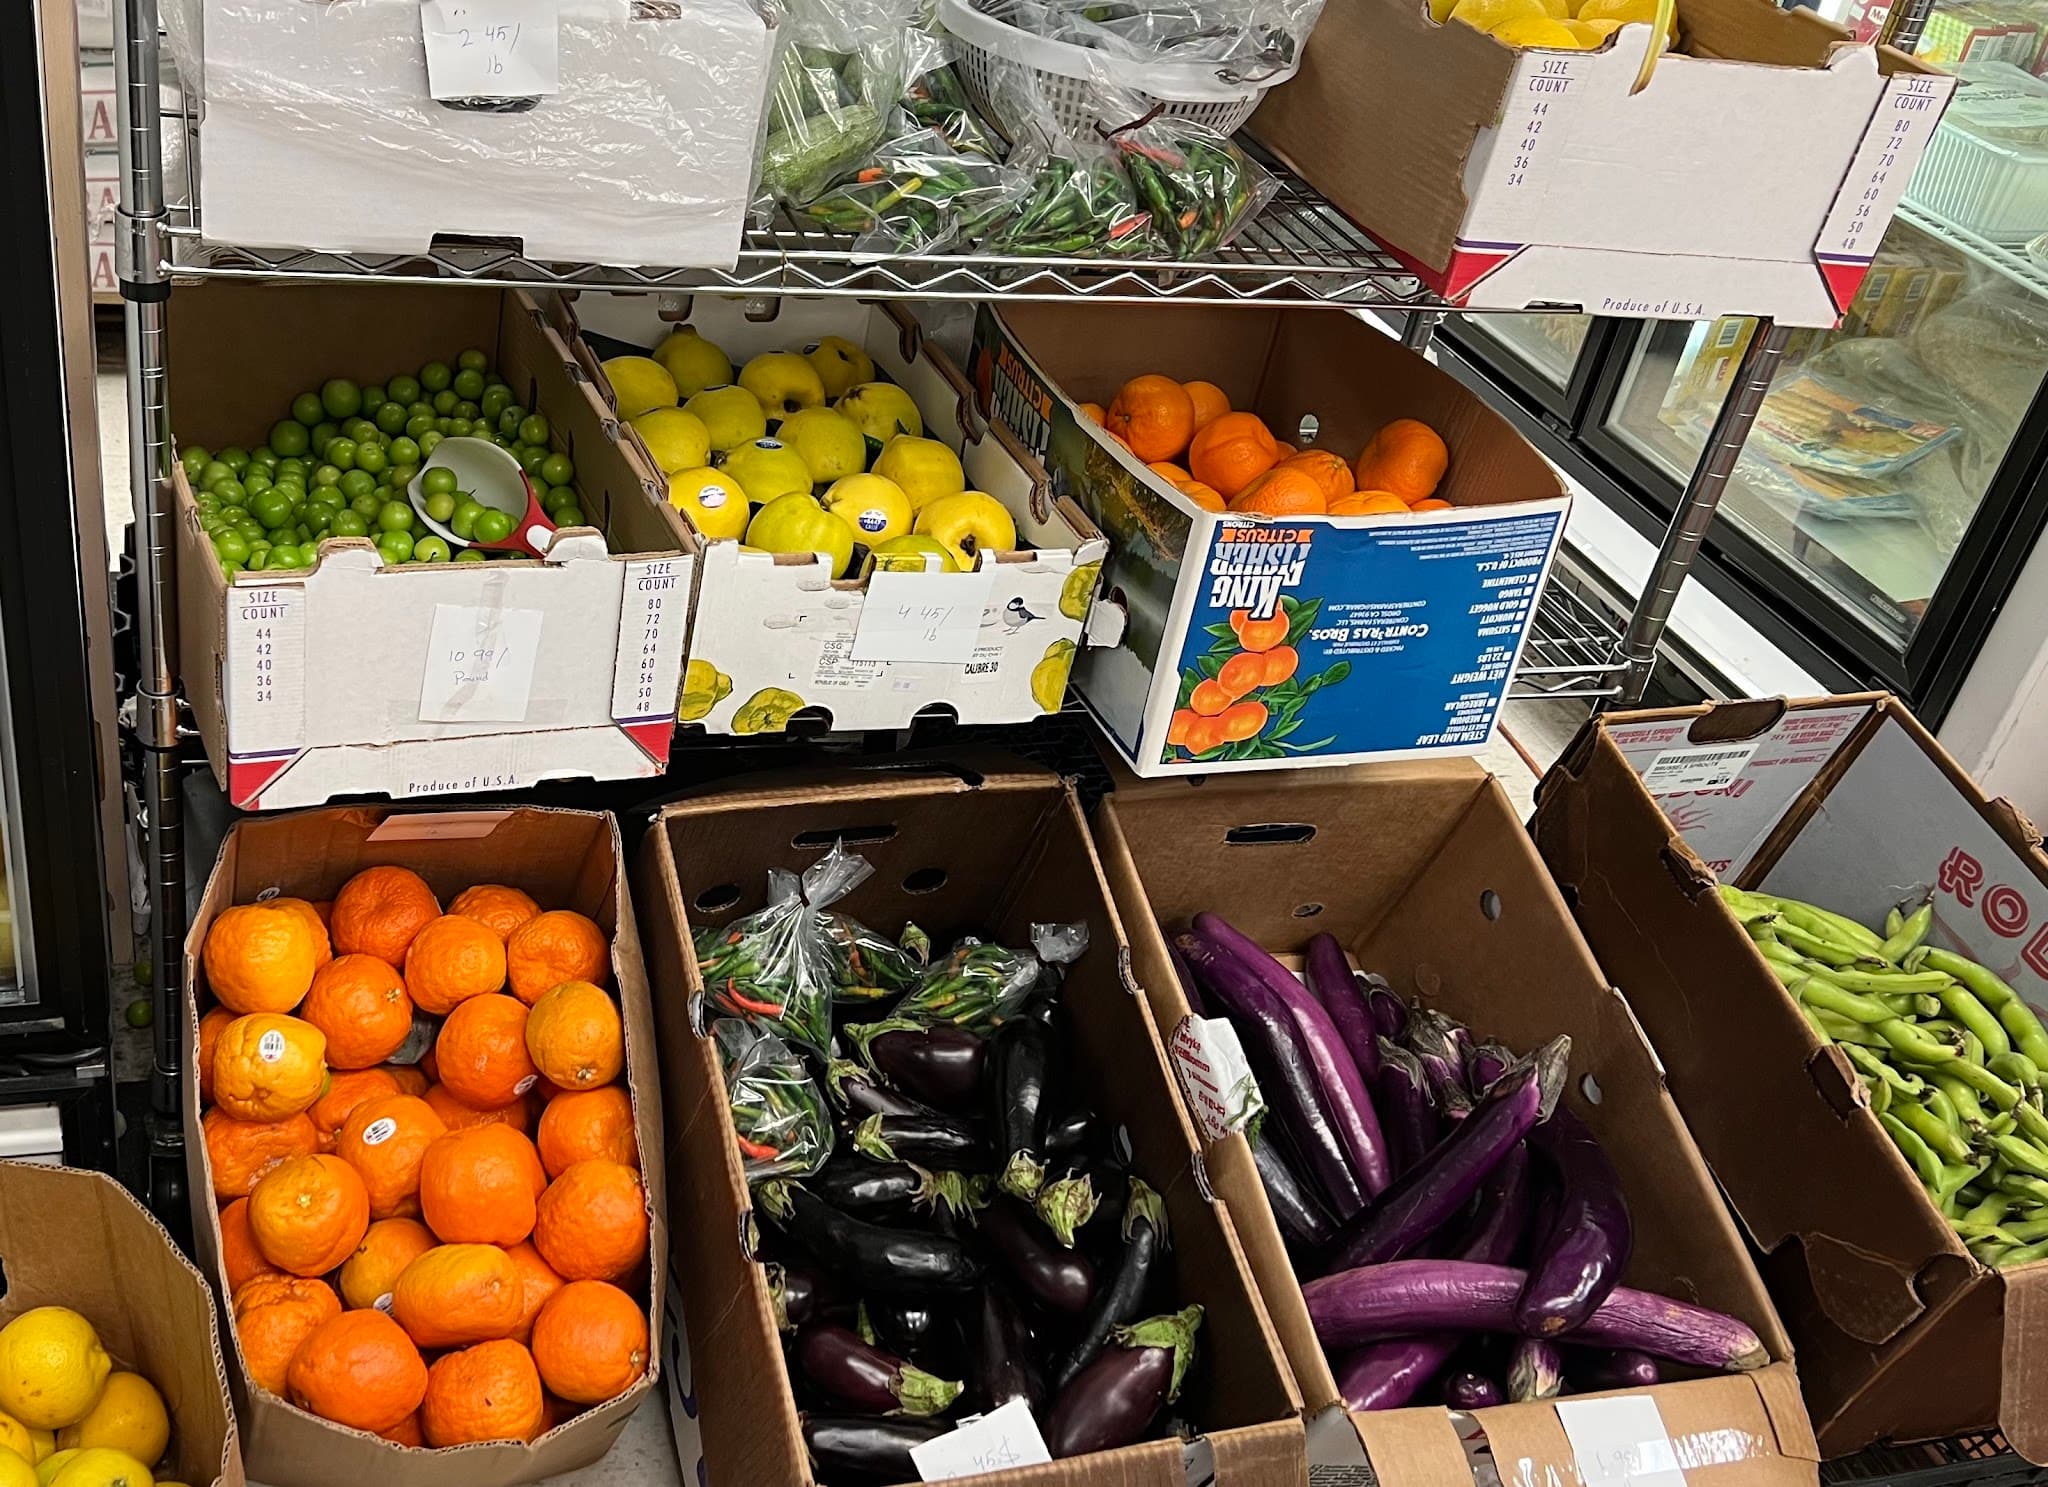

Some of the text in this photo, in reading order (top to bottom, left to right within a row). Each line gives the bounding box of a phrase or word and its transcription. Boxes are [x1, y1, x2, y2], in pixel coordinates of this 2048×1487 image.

[1541, 60, 1569, 75] SIZE
[1529, 78, 1569, 93] COUNT
[1907, 79, 1933, 94] SIZE
[1533, 103, 1549, 116] 44
[1894, 96, 1933, 112] COUNT
[1527, 121, 1542, 134] 42
[1895, 119, 1910, 133] 80
[1520, 138, 1535, 151] 40
[1887, 136, 1903, 150] 72
[1514, 156, 1528, 169] 36
[1879, 154, 1895, 167] 70
[1507, 173, 1523, 186] 34
[1871, 171, 1887, 184] 64
[1864, 188, 1879, 201] 60
[1856, 205, 1871, 217] 56
[1848, 221, 1863, 234] 50
[1842, 237, 1856, 250] 48
[1603, 298, 1706, 316] Produce of U.S.A.
[1236, 529, 1298, 542] CITRUS
[1210, 543, 1312, 586] FISHER
[1498, 560, 1508, 570] OF
[1508, 556, 1543, 568] PRODUCT
[646, 563, 671, 575] SIZE
[638, 578, 676, 591] COUNT
[1482, 575, 1527, 588] CLEMENTINE
[249, 591, 278, 604] SIZE
[1209, 575, 1284, 618] KING
[1498, 588, 1523, 599] TANGO
[648, 599, 662, 610] 80
[1468, 600, 1519, 614] GOLD NUGGET
[242, 607, 286, 620] COUNT
[646, 613, 660, 625] 72
[1480, 612, 1515, 624] MURCOTT
[256, 628, 271, 640] 44
[645, 629, 658, 640] 70
[1309, 627, 1350, 642] BROS.
[1478, 625, 1512, 637] SATSUMA
[256, 644, 272, 655] 42
[643, 644, 656, 655] 64
[824, 642, 844, 650] CSG
[256, 659, 272, 671] 40
[641, 658, 654, 669] 60
[819, 657, 839, 666] CSP
[1476, 654, 1491, 663] LBS
[257, 675, 272, 686] 36
[639, 673, 653, 684] 56
[1450, 669, 1506, 684] NET WEIGHT
[257, 690, 272, 702] 34
[638, 687, 651, 698] 50
[636, 702, 650, 712] 48
[1444, 698, 1487, 711] IRREGULAR
[1449, 714, 1482, 725] MEDIUM
[1415, 730, 1486, 746] STEM AND LEAF
[409, 774, 520, 793] Produce of U.S.A.
